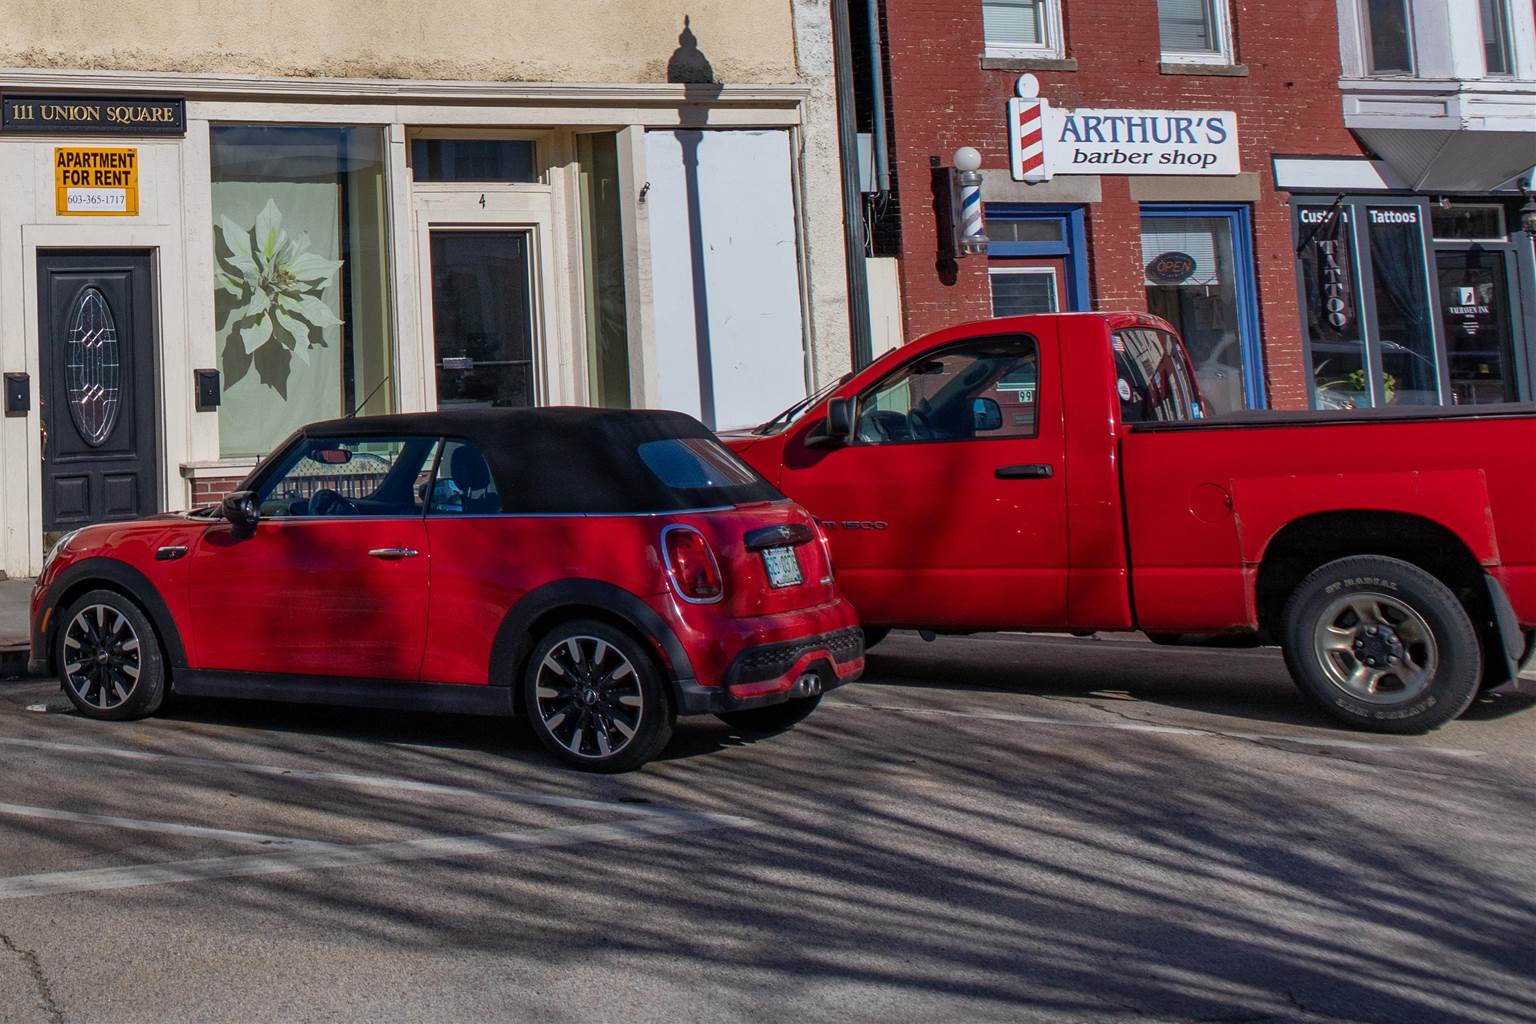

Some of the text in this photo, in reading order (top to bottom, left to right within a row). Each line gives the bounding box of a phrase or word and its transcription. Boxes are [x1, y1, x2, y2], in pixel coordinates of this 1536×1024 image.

[13, 105, 173, 124] 111 UNION SQUARE
[1058, 115, 1227, 144] ARTHUR'S
[57, 152, 135, 169] APARTMENT
[1072, 149, 1217, 169] barber shop
[63, 170, 131, 186] FOR RENT
[67, 195, 125, 205] 603-365-1717
[479, 194, 485, 208] 4
[1370, 210, 1417, 223] Tattoos
[1157, 259, 1192, 273] OPEN
[842, 520, 889, 529] 1500
